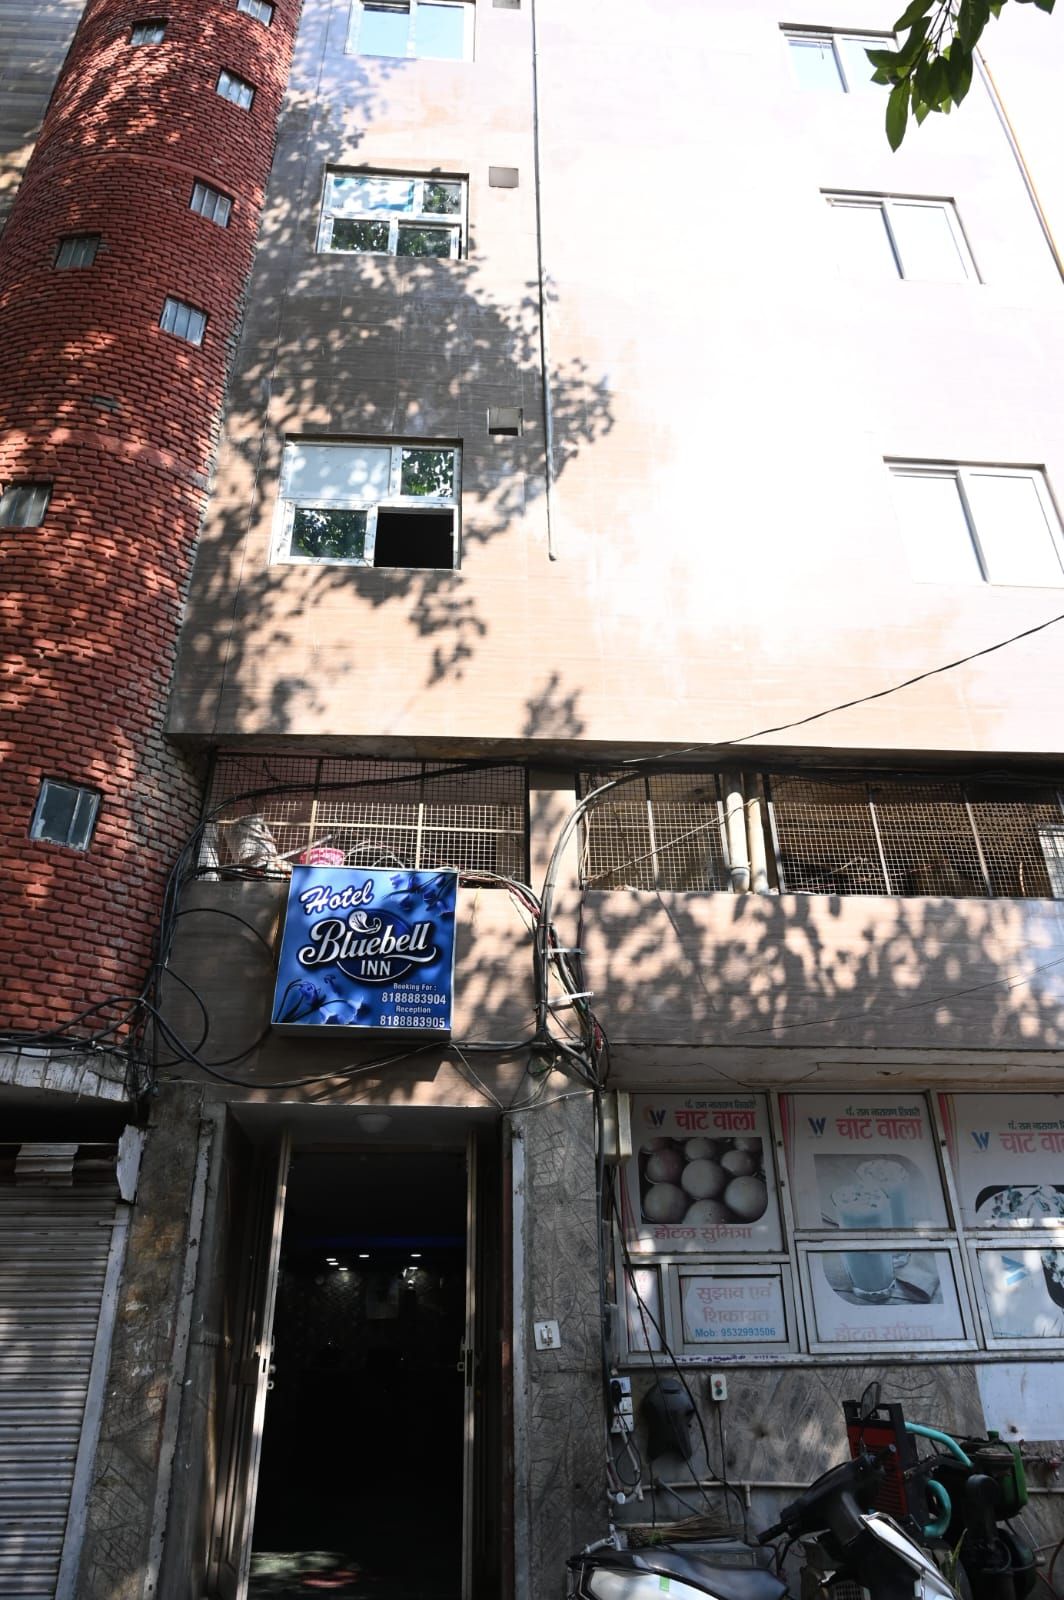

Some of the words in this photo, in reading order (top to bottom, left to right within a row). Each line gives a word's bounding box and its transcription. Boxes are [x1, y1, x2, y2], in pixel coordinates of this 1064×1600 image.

[300, 879, 374, 914] Hotel
[299, 918, 437, 965] Bluebell
[360, 960, 391, 976] INN
[393, 982, 420, 991] Booking
[381, 992, 446, 1004] 8188883904
[396, 1005, 431, 1014] Reception
[380, 1015, 445, 1028] 8188883905
[674, 1110, 709, 1130] चाट
[712, 1110, 756, 1131] वाला
[835, 1118, 872, 1140] चाट
[876, 1118, 923, 1140] वाला
[999, 1132, 1037, 1153] चाट
[1038, 1132, 1064, 1153] वा
[654, 1225, 697, 1240] होटल
[700, 1224, 752, 1244] सुमित्रा
[695, 1287, 744, 1304] सुझाव
[695, 1328, 718, 1338] Mob:
[720, 1327, 776, 1338] 9532993506
